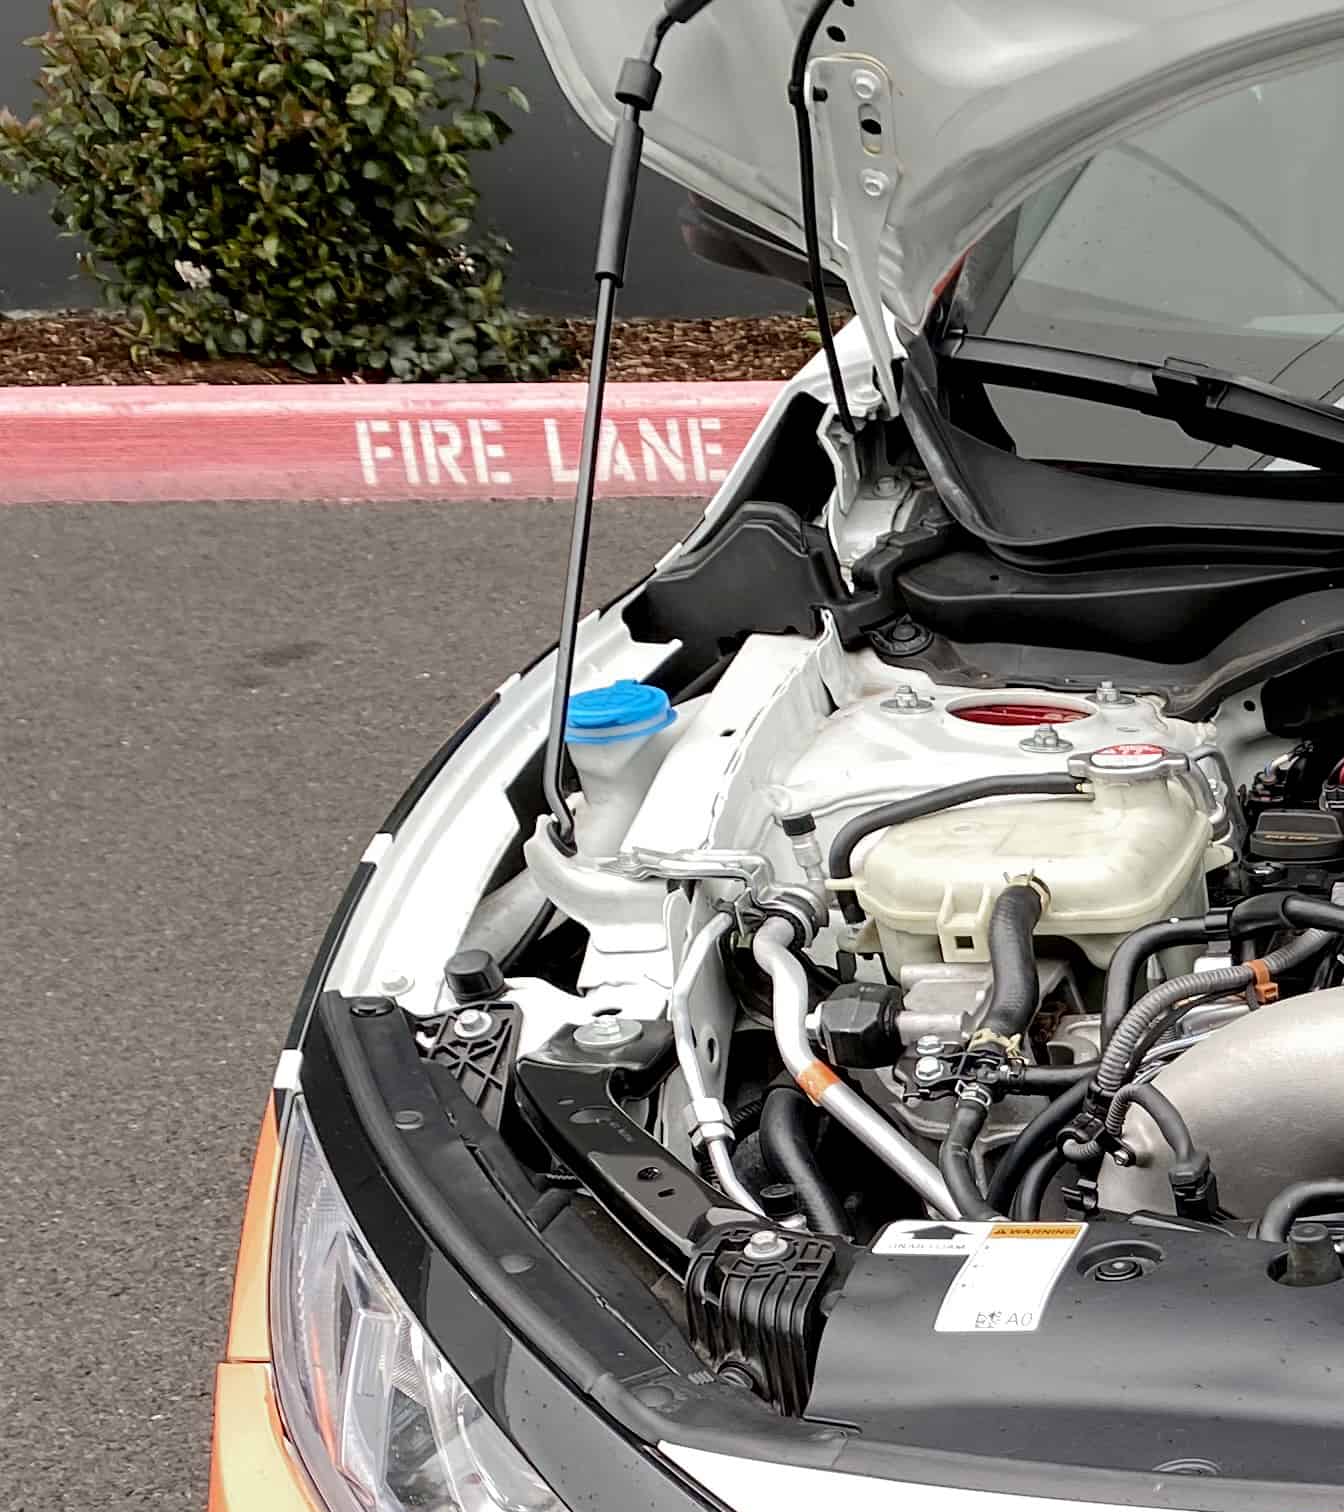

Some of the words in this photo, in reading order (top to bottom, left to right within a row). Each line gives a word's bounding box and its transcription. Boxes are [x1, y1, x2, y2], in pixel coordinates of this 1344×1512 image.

[355, 418, 513, 485] FIRE
[543, 416, 728, 484] LANE
[1008, 1227, 1077, 1237] WARNING
